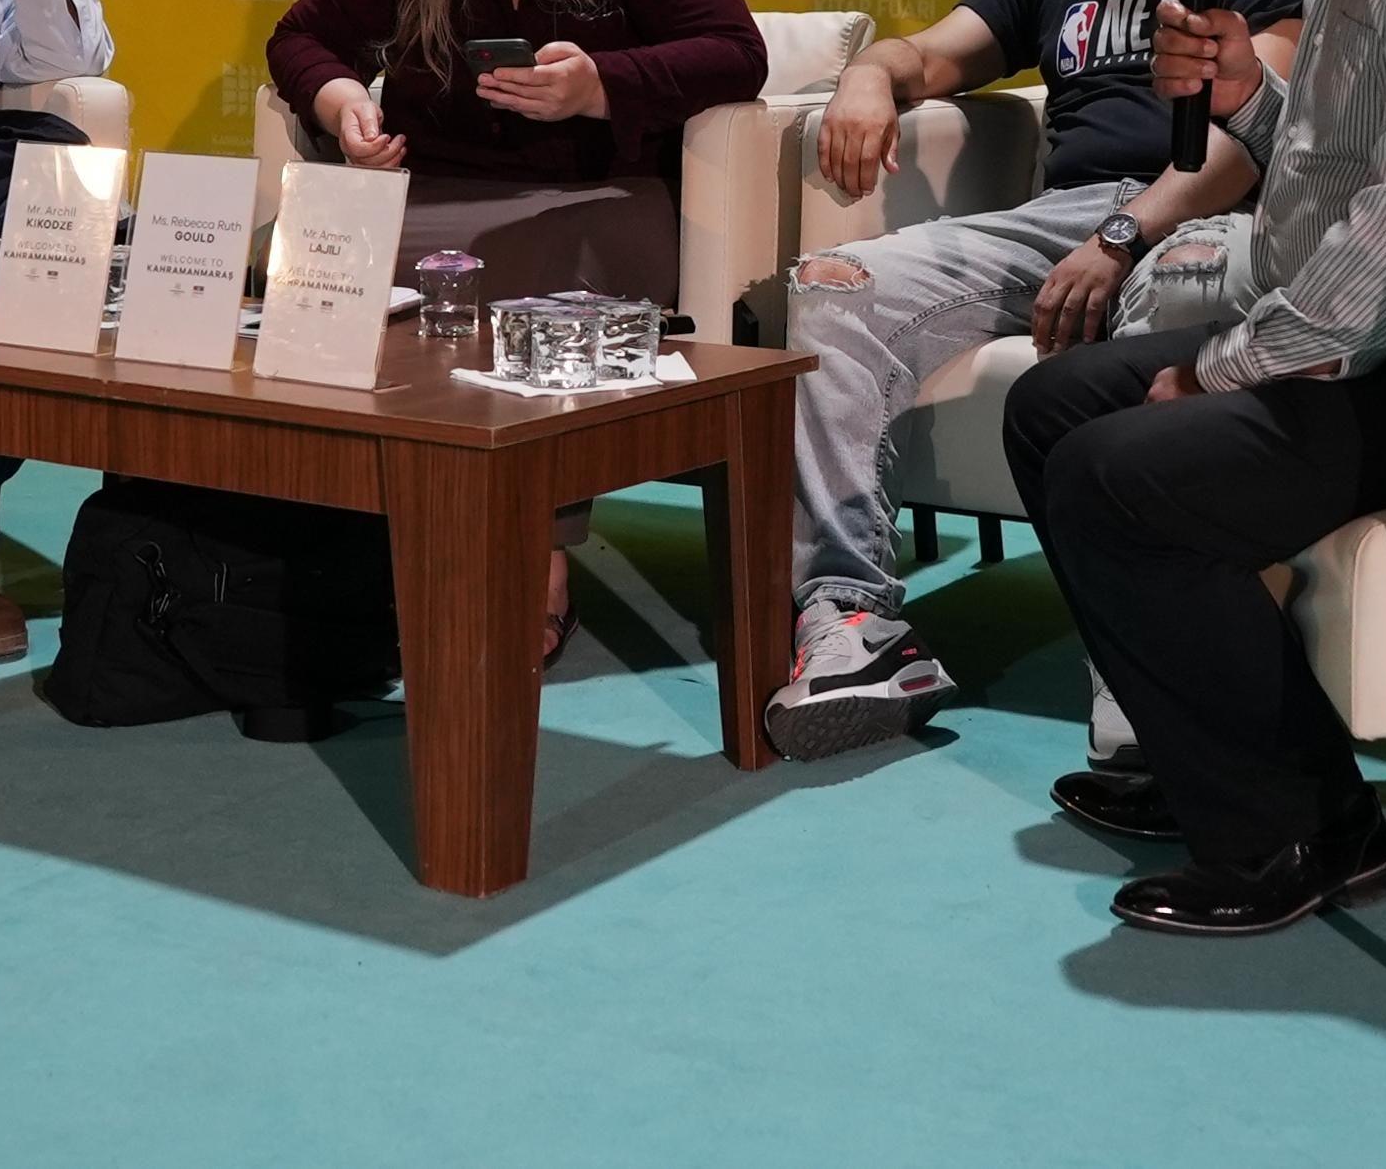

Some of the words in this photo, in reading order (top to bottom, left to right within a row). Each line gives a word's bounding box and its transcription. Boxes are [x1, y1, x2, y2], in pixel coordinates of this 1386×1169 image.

[171, 216, 215, 230] Rebecca
[217, 220, 242, 232] Ruth
[174, 230, 215, 244] GOULD
[160, 254, 207, 267] WELCOME
[211, 258, 224, 268] TO
[146, 264, 234, 281] KAHRAMANMARAŞ
